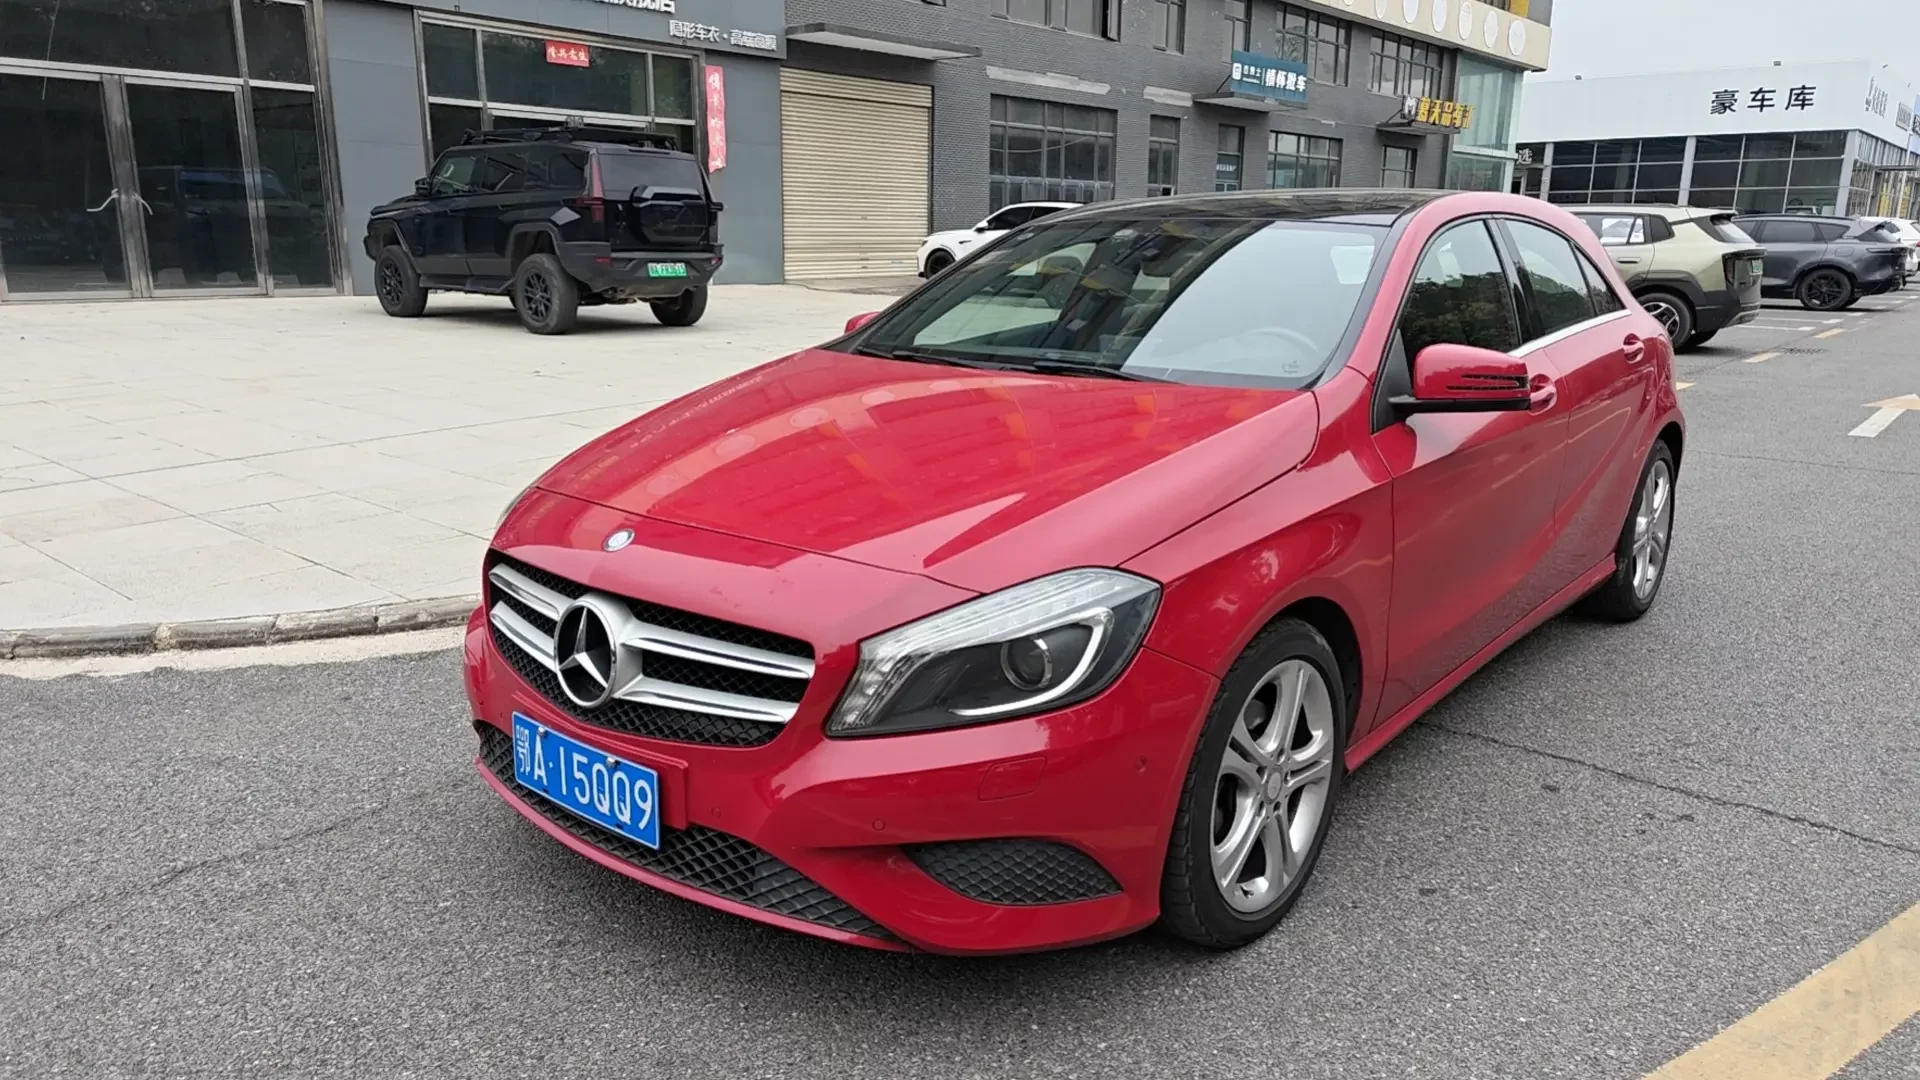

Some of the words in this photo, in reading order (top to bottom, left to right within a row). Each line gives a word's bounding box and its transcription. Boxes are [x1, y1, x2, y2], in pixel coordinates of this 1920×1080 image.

[1710, 84, 1816, 115] 豪车库
[516, 724, 653, 830] 鄂A·15QQ9
